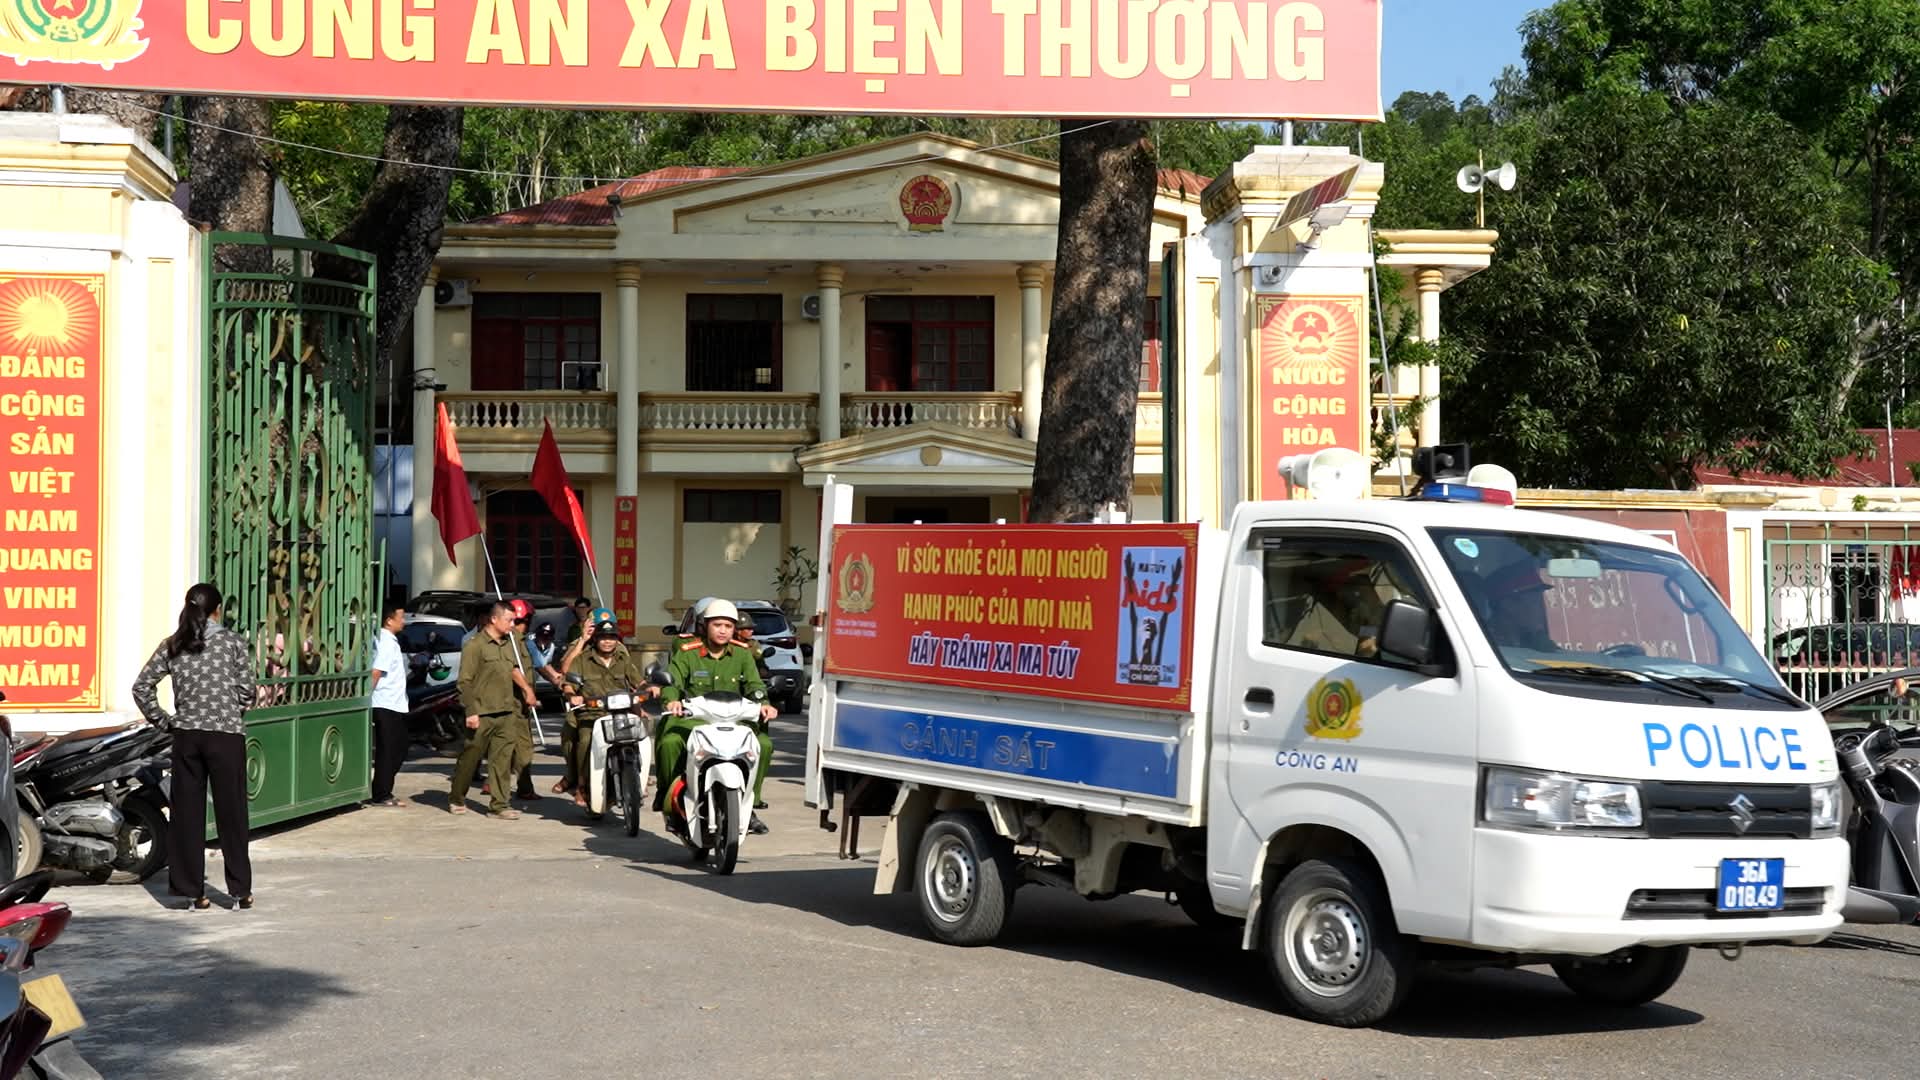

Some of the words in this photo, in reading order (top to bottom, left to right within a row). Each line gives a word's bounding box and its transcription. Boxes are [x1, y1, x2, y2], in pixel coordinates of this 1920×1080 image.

[465, 0, 589, 66] AN
[991, 0, 1326, 97] THƯỢNG
[0, 348, 86, 379] ĐẢNG
[0, 389, 86, 421] CỘNG
[1272, 393, 1346, 419] CỘNG
[10, 425, 75, 455] SẢN
[1282, 423, 1337, 446] HÒA
[9, 467, 75, 498] VIỆT
[5, 509, 78, 532] NAM
[897, 542, 910, 573] VÌ
[913, 542, 942, 574] SỨC
[944, 539, 982, 576] KHỎE
[986, 539, 1017, 577] CỦA
[1021, 548, 1052, 583] MỌI
[1056, 543, 1109, 580] NGƯỜI
[4, 586, 77, 609] VINH
[903, 593, 942, 625] HẠNH
[945, 590, 984, 624] PHÚC
[988, 588, 1019, 625] CỦA
[1023, 598, 1053, 634] MỌI
[1058, 595, 1093, 630] NHÀ
[0, 621, 86, 648] MUÔN
[908, 631, 940, 666] HÃY
[941, 633, 991, 671] TRÁNH
[992, 640, 1014, 673] XA
[1016, 643, 1043, 676] MA
[1047, 640, 1080, 680] TÚY
[0, 659, 80, 687] NĂM!
[901, 716, 978, 759] CẢNH
[993, 731, 1057, 770] SÁT
[1642, 722, 1807, 771] POLICE
[1275, 749, 1327, 770] CÔNG
[1331, 756, 1358, 773] AN
[1737, 860, 1769, 883] 36A
[1725, 884, 1778, 908] 018.49
